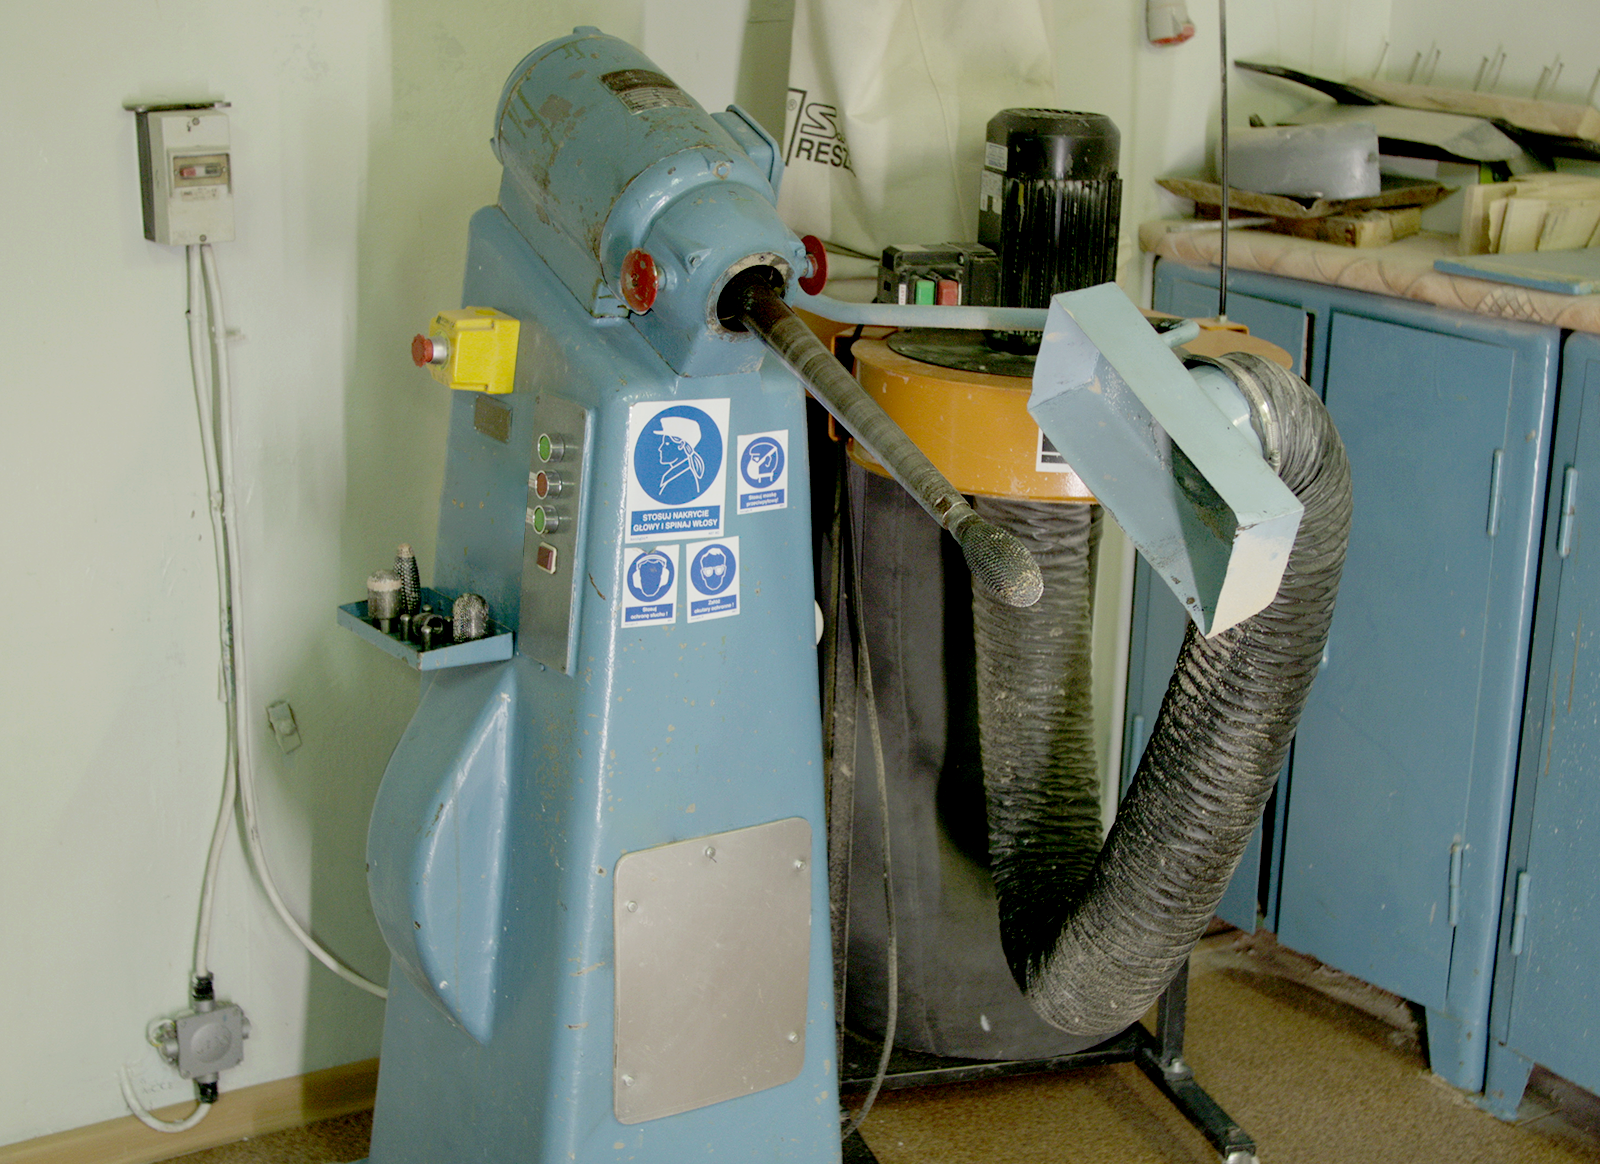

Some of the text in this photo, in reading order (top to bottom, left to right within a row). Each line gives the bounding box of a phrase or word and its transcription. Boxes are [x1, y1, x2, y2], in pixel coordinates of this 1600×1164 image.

[642, 509, 710, 522] STOSUJ NAKRYCIE
[633, 522, 661, 532] GŁOWY
[665, 520, 692, 530] SPINAJ
[692, 518, 718, 528] WŁOSY
